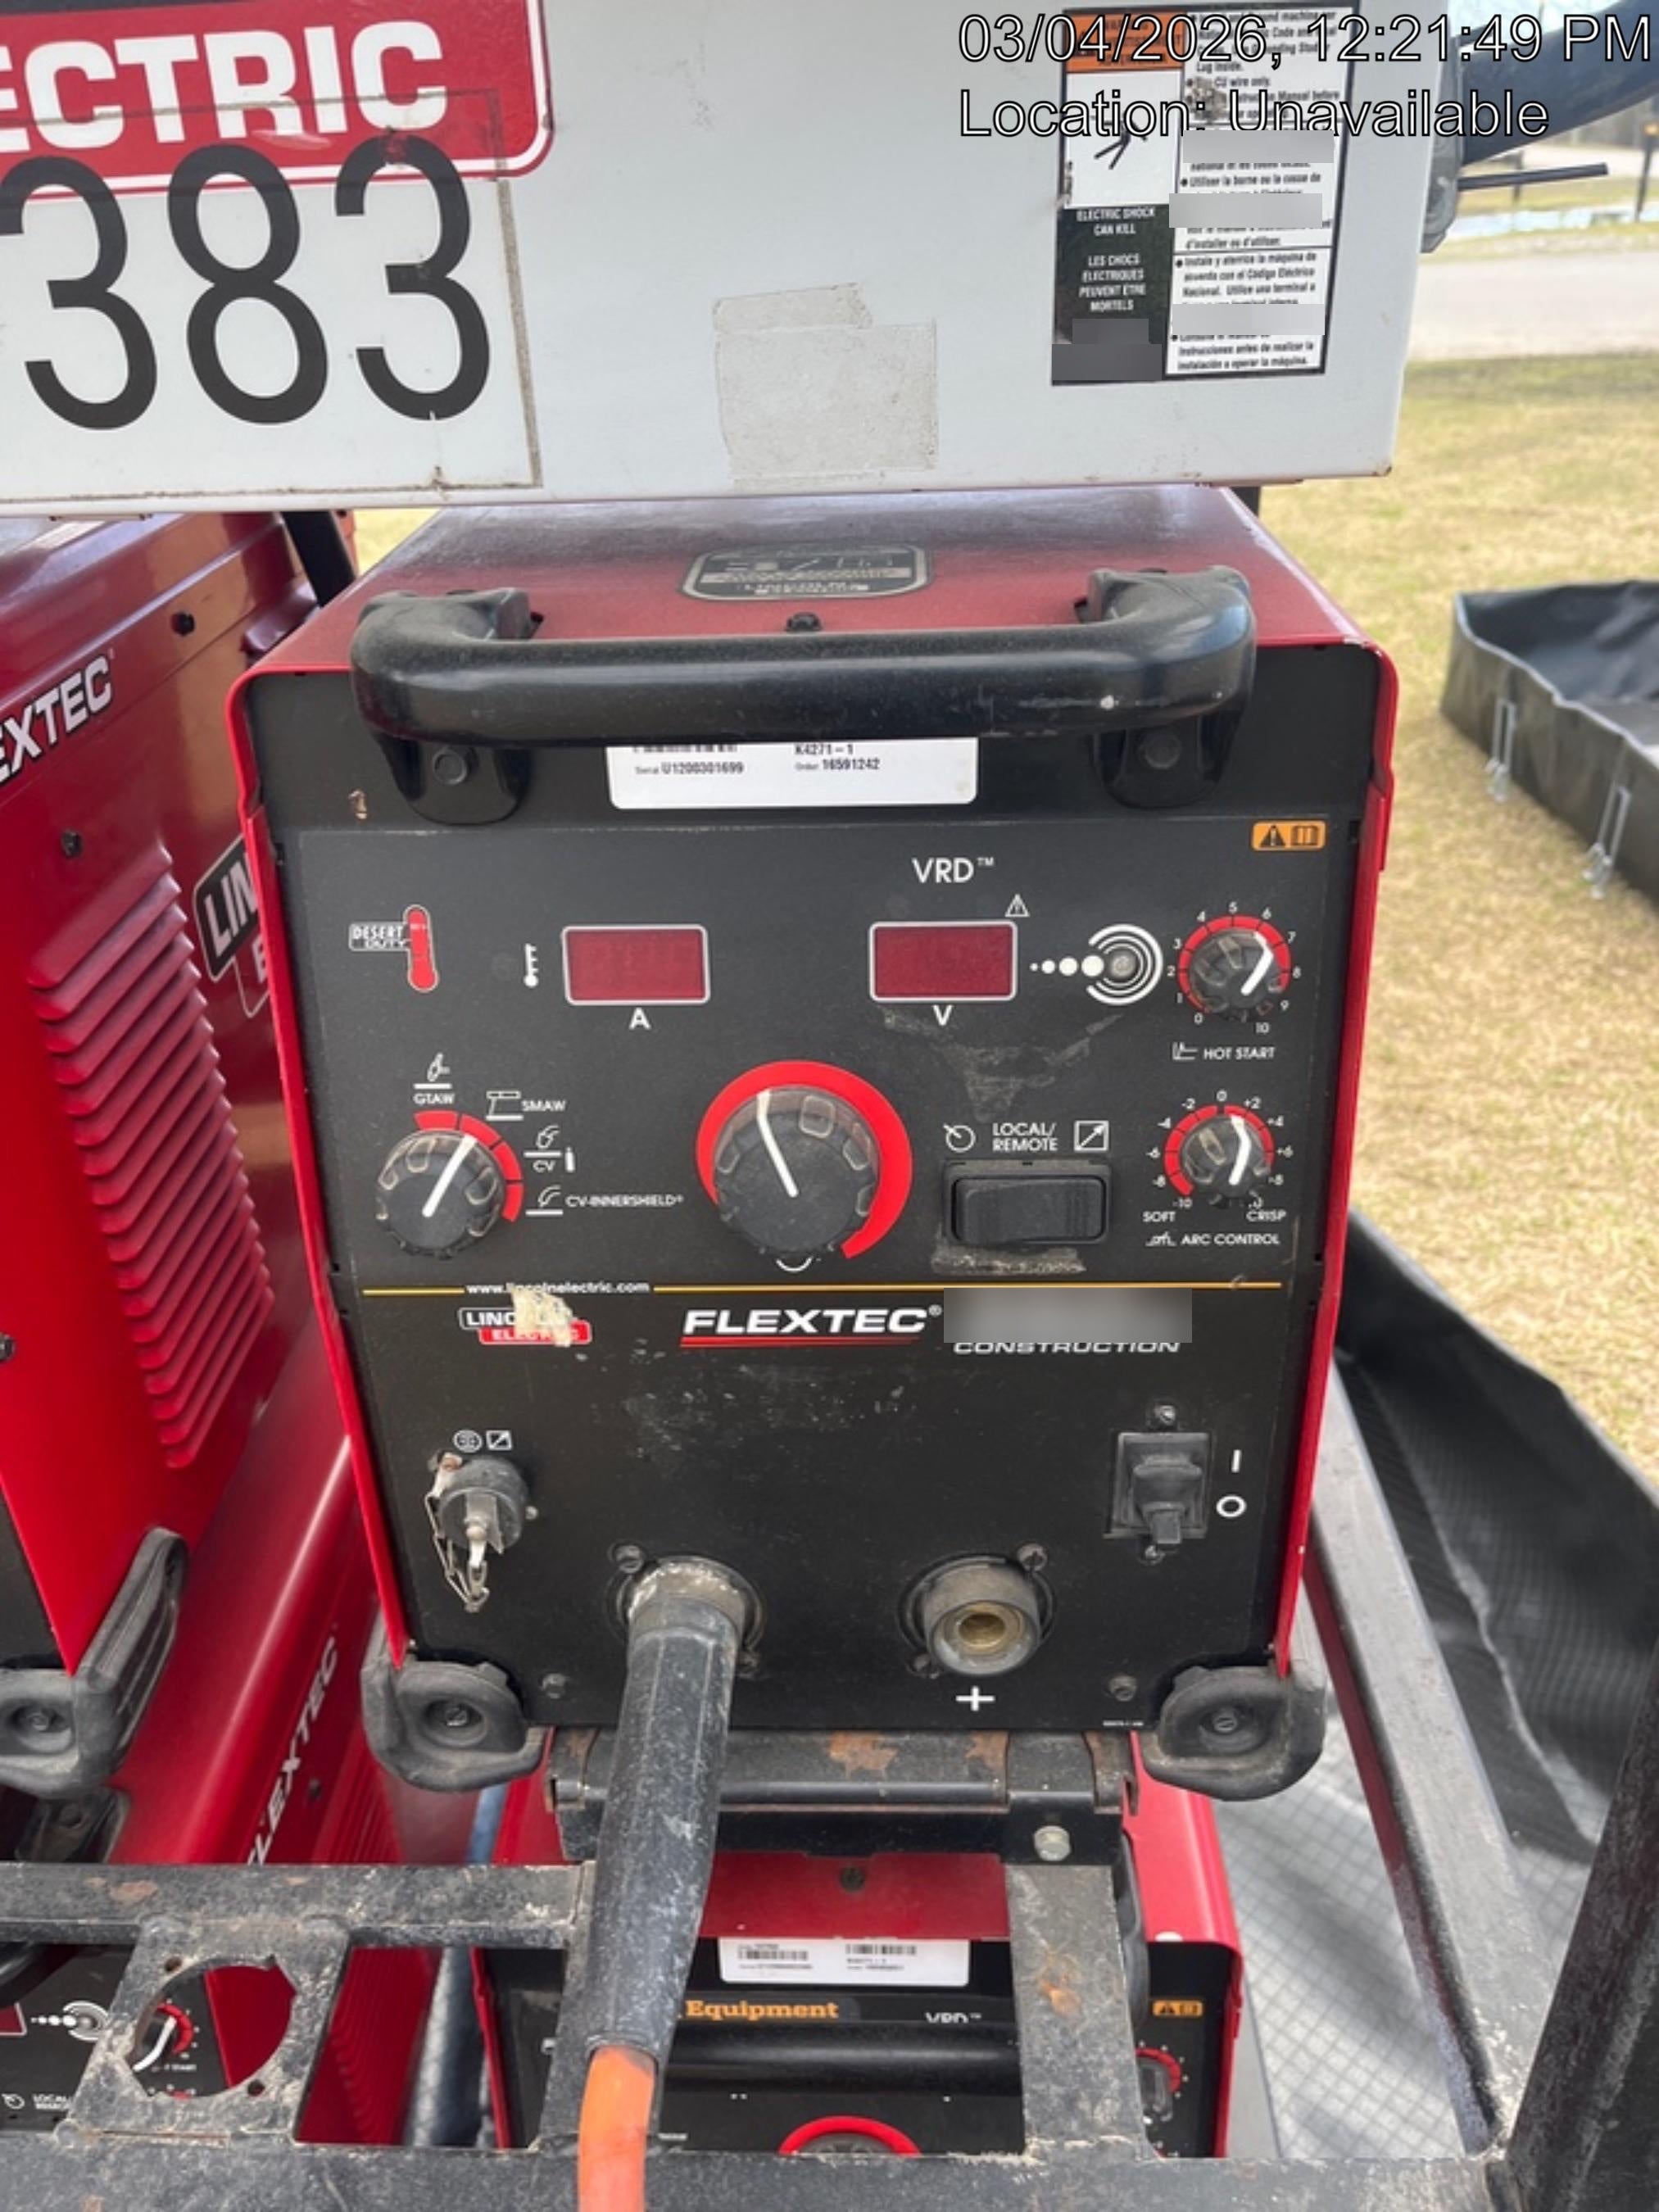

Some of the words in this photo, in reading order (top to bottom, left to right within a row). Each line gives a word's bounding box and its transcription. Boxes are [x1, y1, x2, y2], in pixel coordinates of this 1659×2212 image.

[1076, 208, 1122, 222] ELECTRIC
[1123, 206, 1156, 220] SHOCK
[1094, 224, 1114, 236] CAN
[1116, 222, 1136, 234] KILL
[1088, 255, 1106, 267] LES
[1108, 253, 1140, 265] CHOCS
[0, 134, 490, 430] 383
[1078, 284, 1122, 298] PEUVENT
[1090, 299, 1135, 313] MORTELS
[1229, 902, 1238, 913] 5
[1262, 907, 1271, 919] 6
[1197, 911, 1206, 922] 4
[353, 925, 403, 940] DESERT
[1287, 931, 1297, 943] 7
[1173, 937, 1181, 949] 3
[1167, 965, 1176, 977] 2
[1293, 968, 1301, 978] 8
[1281, 999, 1290, 1011] 9
[629, 1007, 650, 1031] A
[931, 1004, 954, 1027] V
[1256, 1022, 1270, 1034] 10
[1203, 1047, 1233, 1060] HOT
[1235, 1046, 1276, 1059] START
[414, 1093, 456, 1105] GTAW
[1216, 1090, 1227, 1102] 0
[1244, 1096, 1261, 1109] +2
[522, 1099, 566, 1112] SMAW
[1181, 1098, 1195, 1109] -2
[992, 1122, 1057, 1136] LOCAL/
[992, 1137, 1058, 1152] REMOTE
[533, 1159, 555, 1173] CV
[1143, 1211, 1176, 1222] SOFT
[1246, 1209, 1287, 1222] CRISP
[1181, 1233, 1212, 1245] ARC
[1214, 1232, 1280, 1245] CONTROL
[953, 1342, 1181, 1354] CONSTRUCTION
[686, 1999, 839, 2022] Equipment
